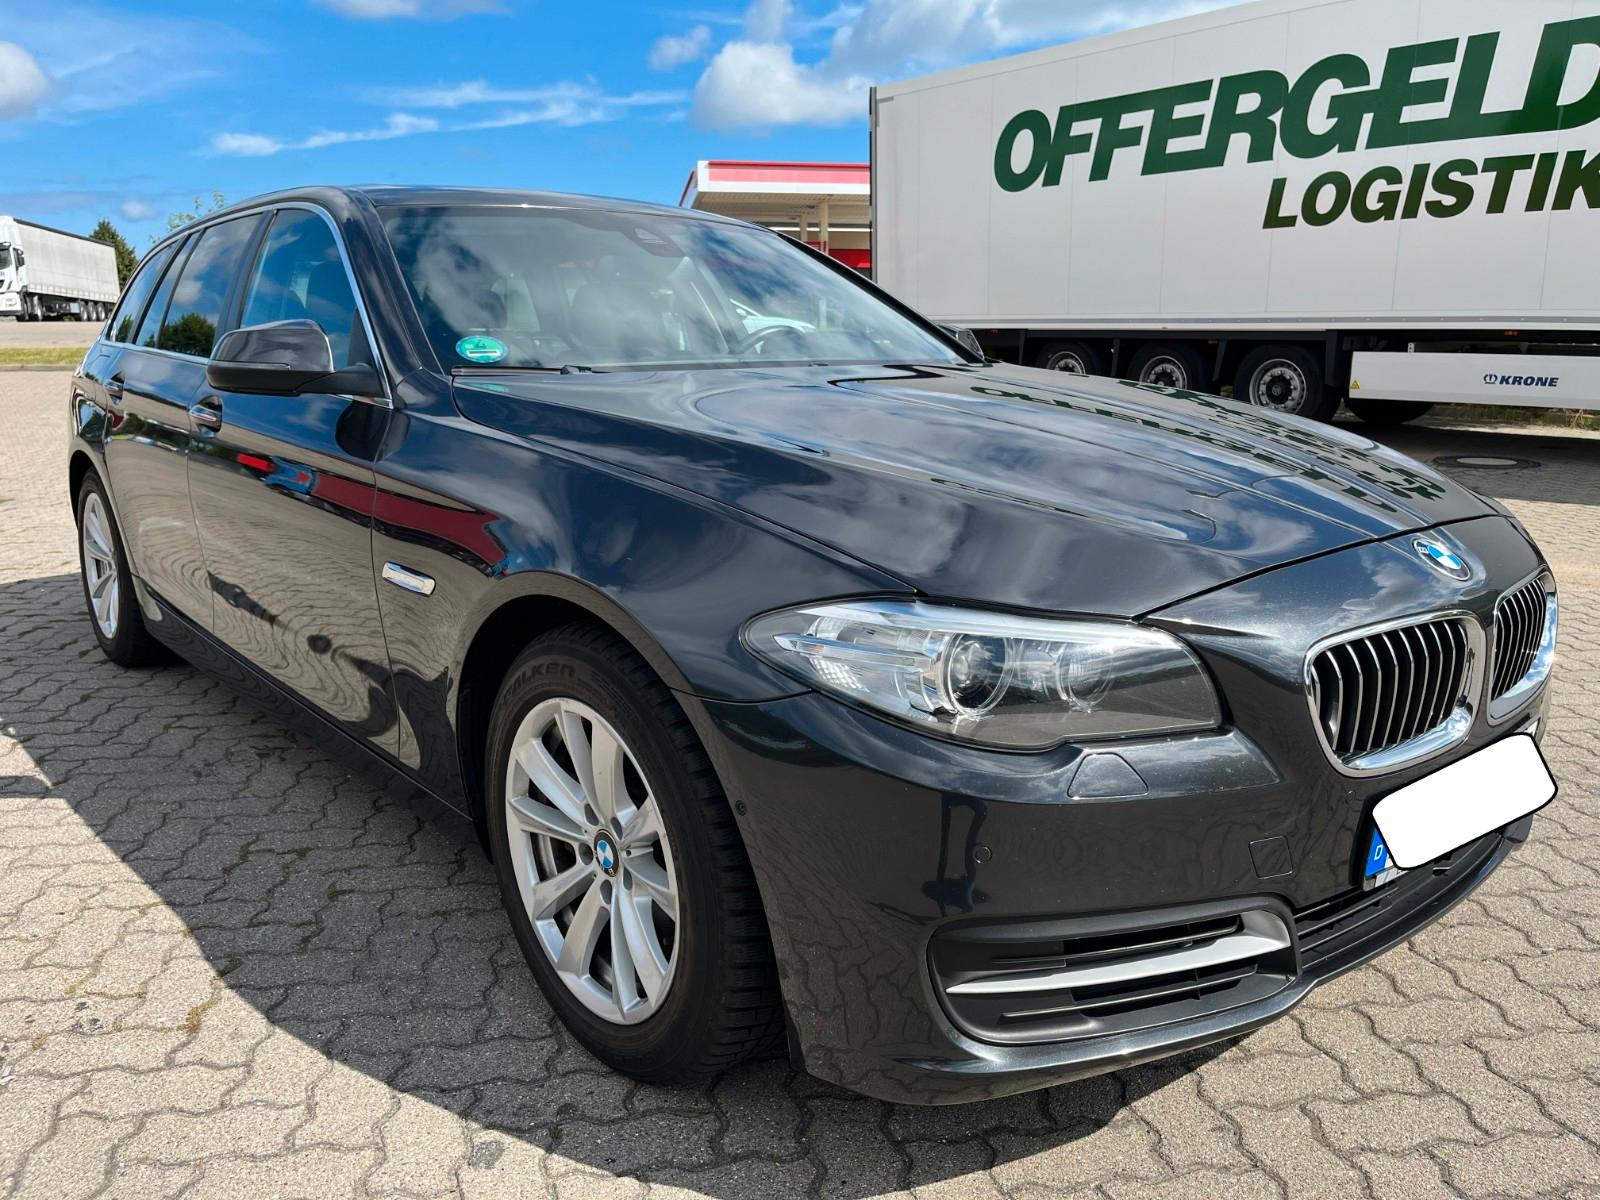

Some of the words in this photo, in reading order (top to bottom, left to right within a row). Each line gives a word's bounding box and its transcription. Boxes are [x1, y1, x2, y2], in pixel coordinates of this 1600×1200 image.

[994, 15, 1600, 192] OFFERGELD
[1262, 149, 1600, 229] LOGISTIK
[1499, 375, 1559, 387] KRONE
[1374, 844, 1384, 860] D
